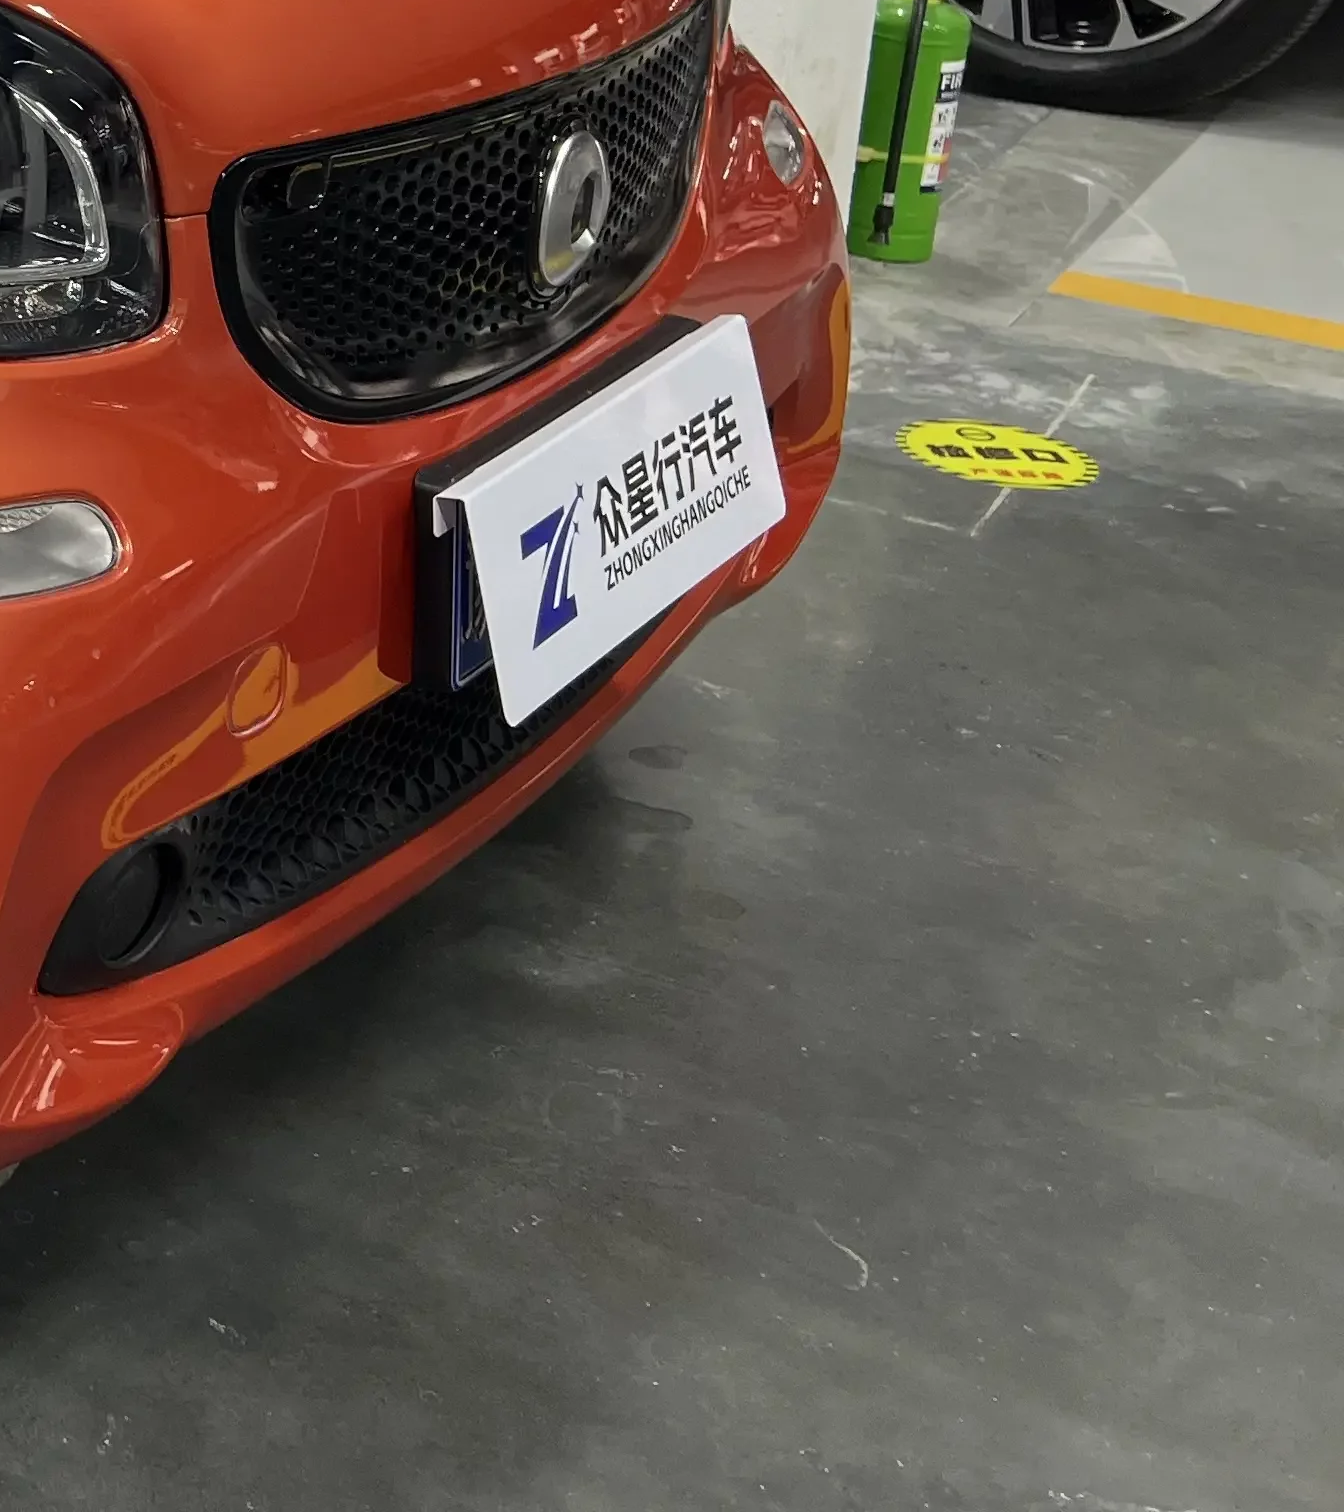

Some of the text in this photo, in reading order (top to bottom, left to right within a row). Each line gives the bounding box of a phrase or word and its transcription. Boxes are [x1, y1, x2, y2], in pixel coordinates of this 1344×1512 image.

[592, 395, 742, 557] 众星行汽车
[604, 464, 752, 591] ZHONGXINGHANGQICHE
